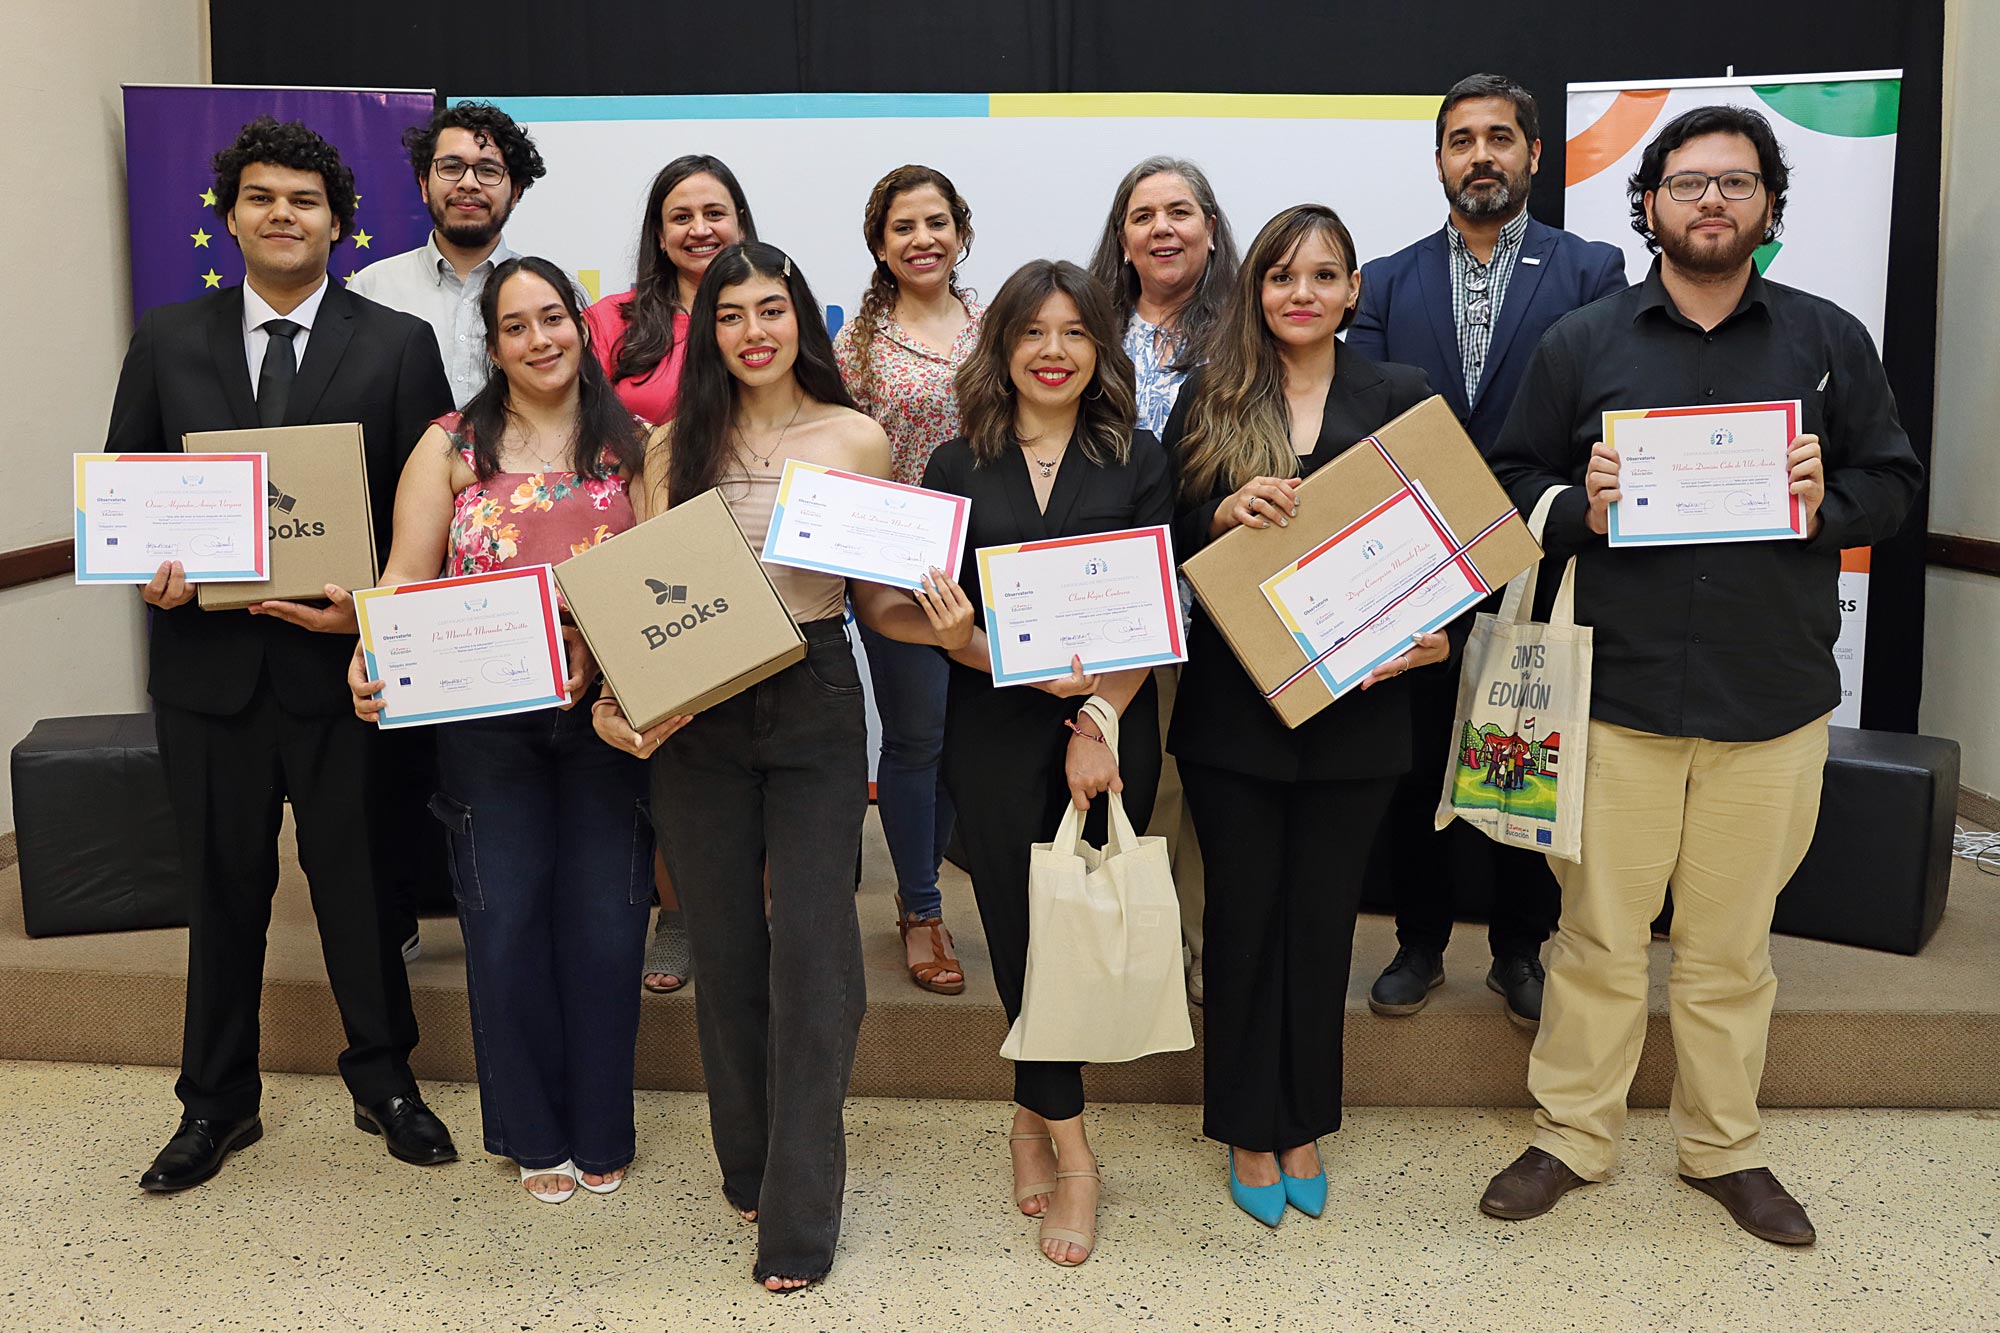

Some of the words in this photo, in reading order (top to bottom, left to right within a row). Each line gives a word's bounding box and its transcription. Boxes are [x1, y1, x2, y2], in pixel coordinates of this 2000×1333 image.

[268, 518, 325, 541] ooks
[1839, 600, 1857, 612] RS
[641, 597, 729, 650] Books
